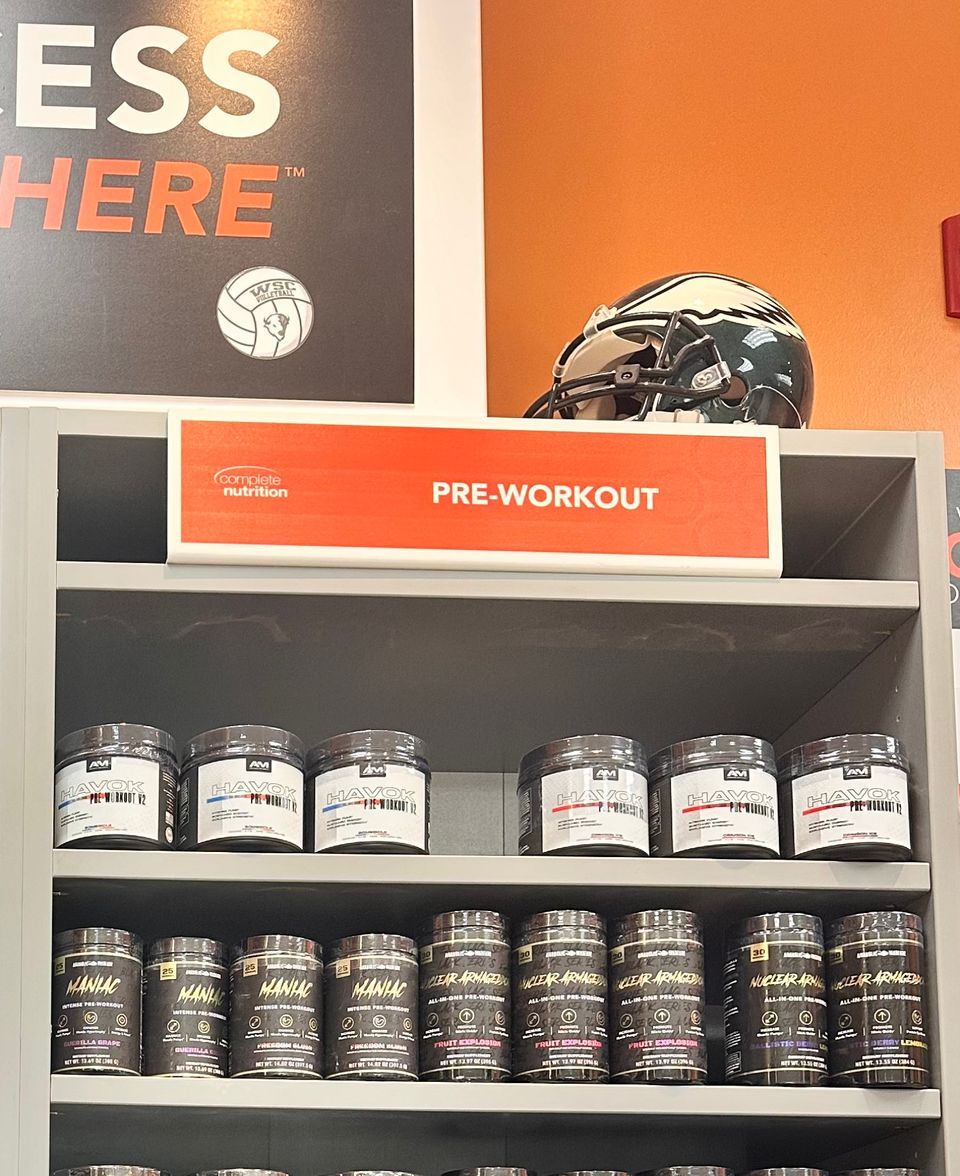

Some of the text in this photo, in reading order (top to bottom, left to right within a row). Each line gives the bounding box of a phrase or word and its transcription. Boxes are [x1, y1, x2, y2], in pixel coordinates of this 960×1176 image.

[250, 281, 297, 297] WSC
[255, 290, 295, 303] VOLLEYBALL
[219, 472, 281, 488] complete
[223, 484, 288, 500] nutrition
[431, 480, 660, 511] PRE-WORKOUT
[60, 780, 145, 801] HAVOK
[212, 781, 296, 801] HAVOK
[326, 786, 415, 805] HAVOK
[557, 790, 644, 806] HAVOK
[687, 789, 773, 806] HAVOK
[807, 788, 900, 808] HAVOK
[753, 948, 766, 956] 30
[161, 967, 174, 975] 25
[66, 973, 121, 997] MANIAC
[258, 976, 313, 1000] MANIAC
[351, 976, 408, 1000] MANIAC
[434, 1040, 458, 1048] FRUIT
[535, 1040, 559, 1048] FRUIT
[628, 1040, 653, 1049] FRUIT
